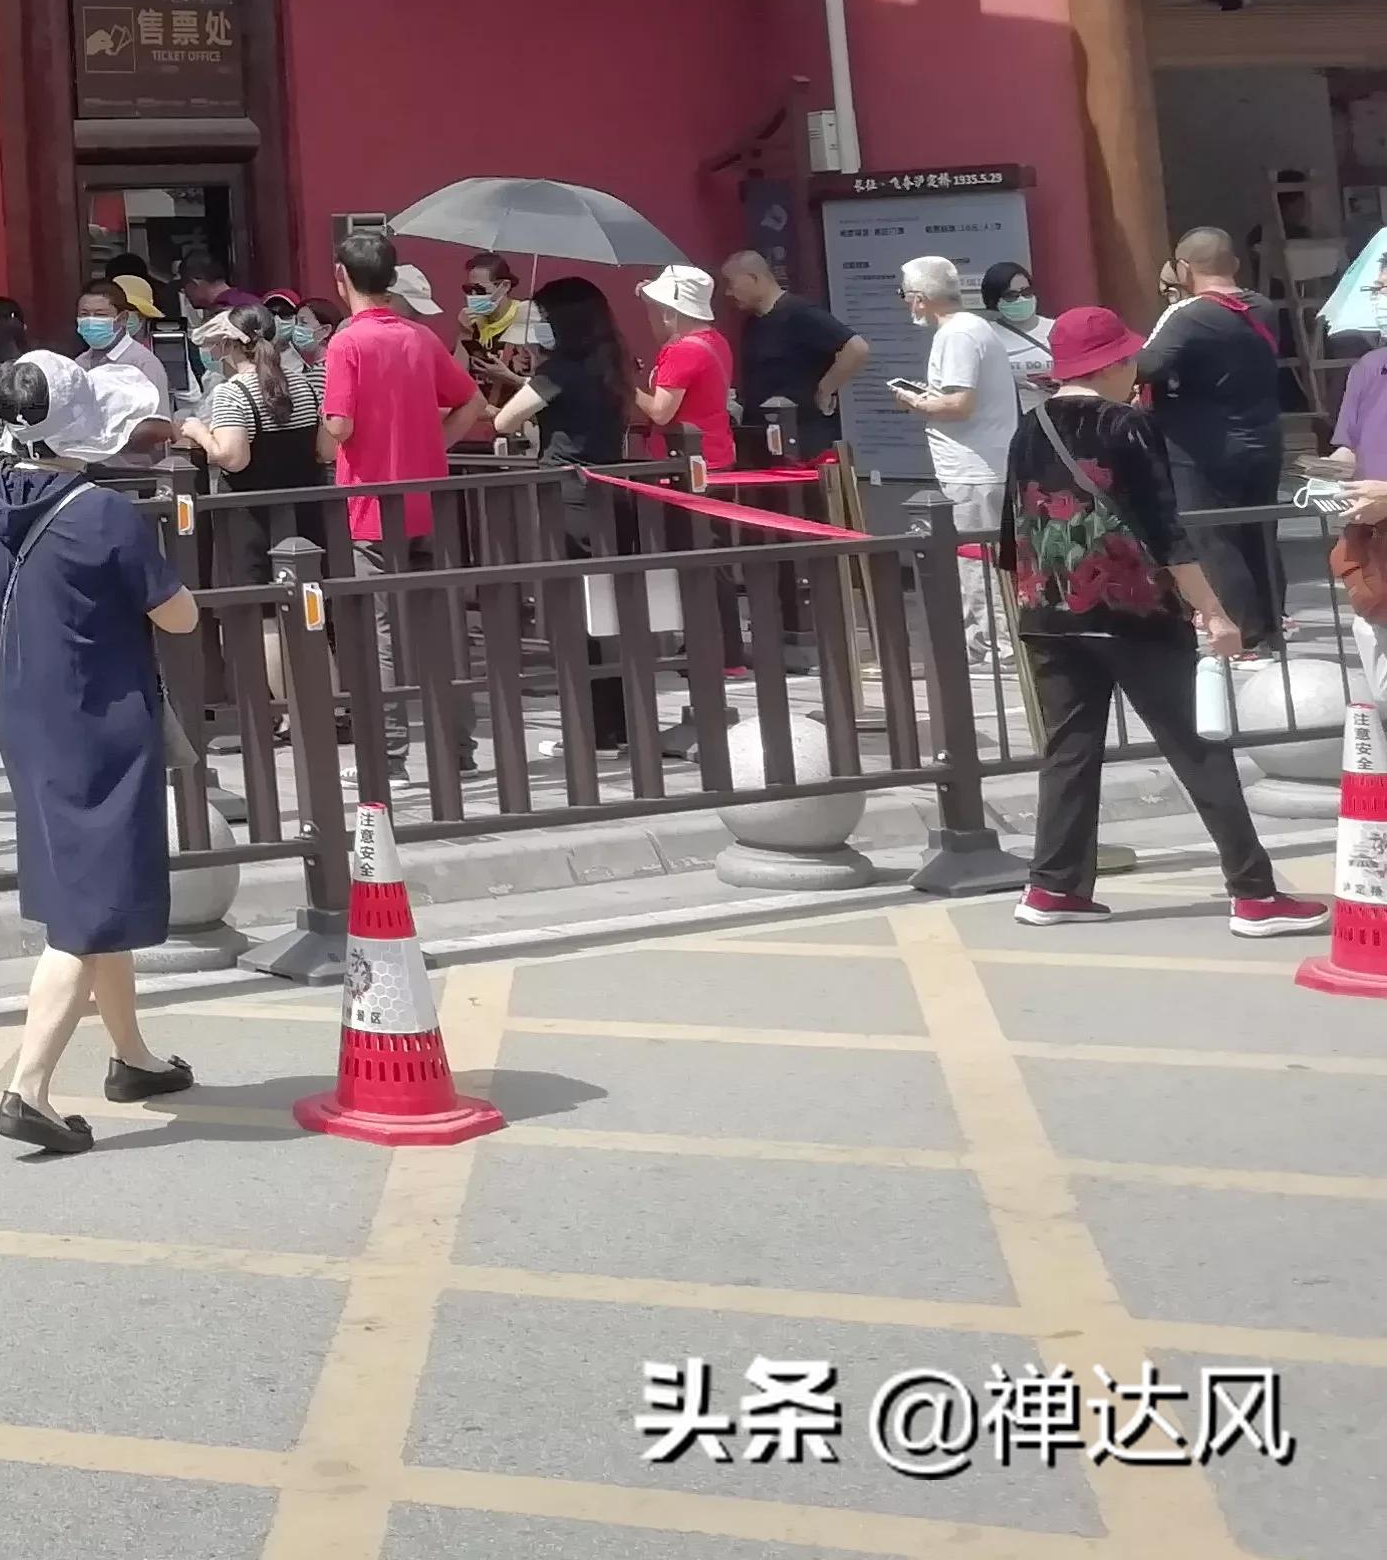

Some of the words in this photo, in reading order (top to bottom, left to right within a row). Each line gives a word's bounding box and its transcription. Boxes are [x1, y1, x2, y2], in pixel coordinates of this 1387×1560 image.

[137, 8, 233, 47] 售票处
[151, 50, 185, 62] TICKET
[188, 50, 221, 62] OFFICE
[1352, 712, 1374, 771] 注意安全
[358, 811, 376, 878] 注意安全
